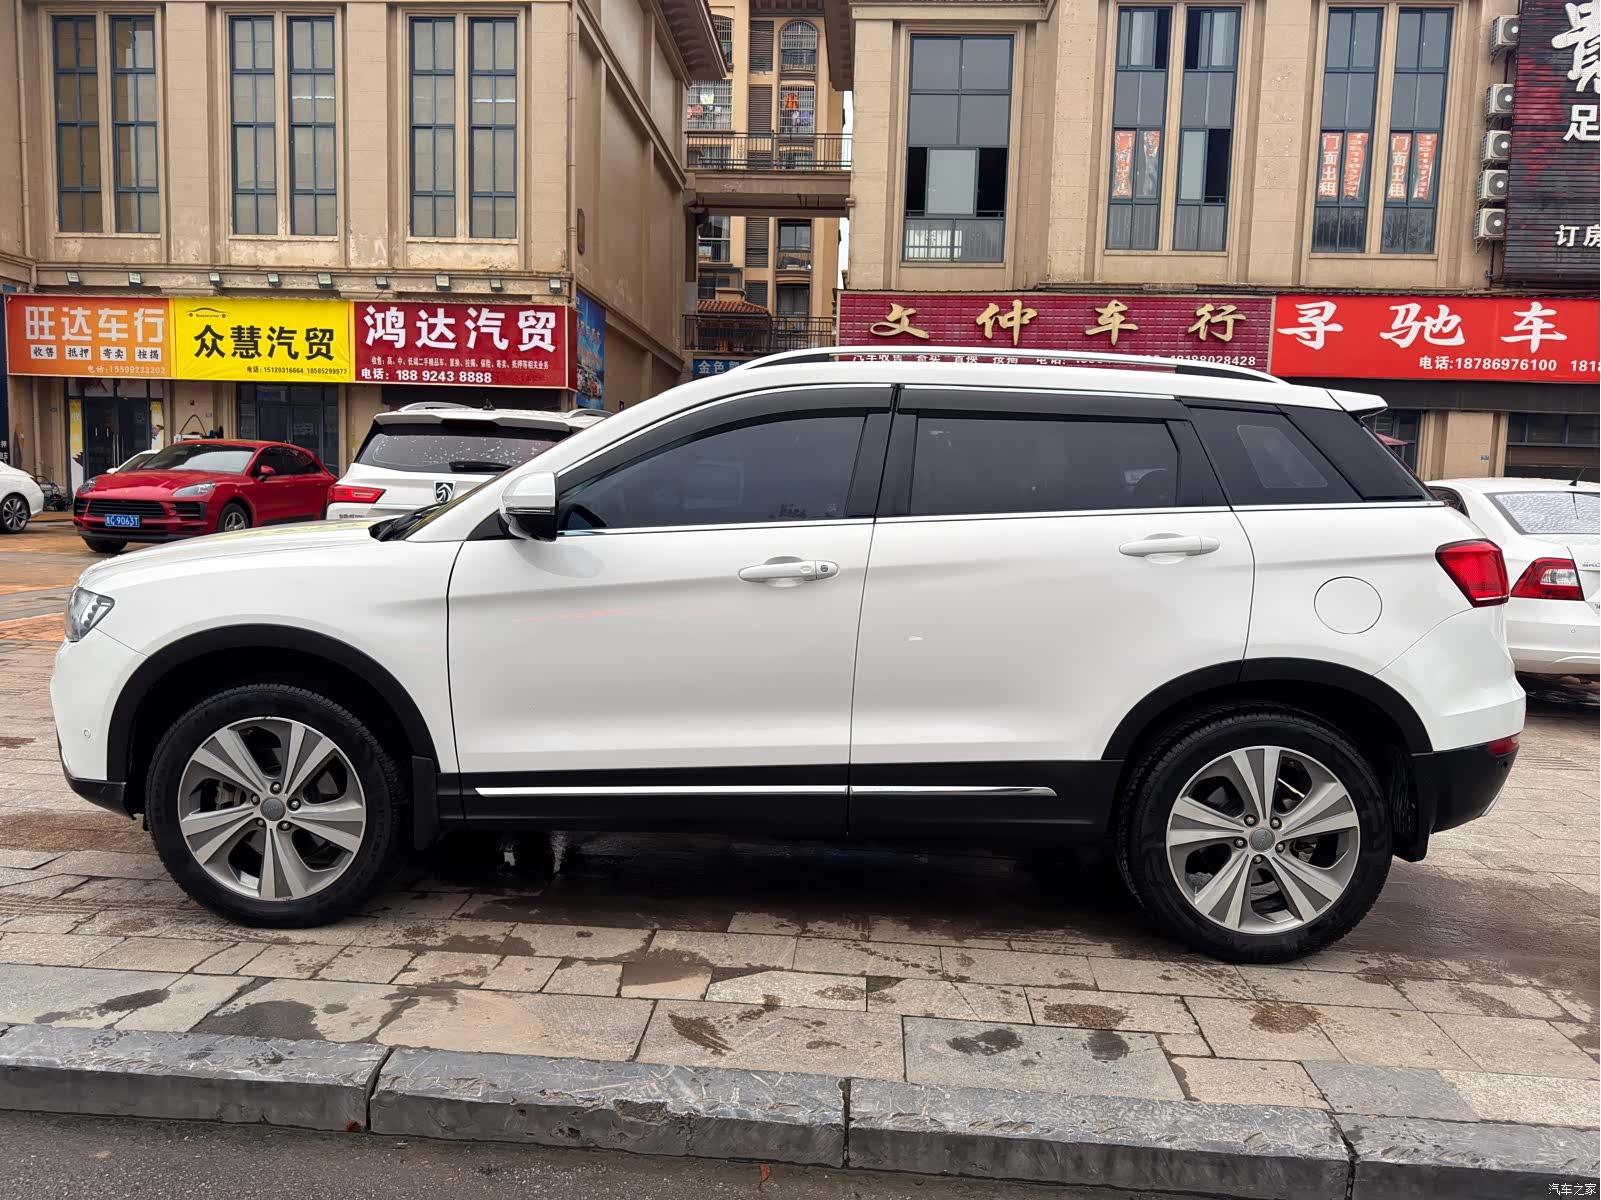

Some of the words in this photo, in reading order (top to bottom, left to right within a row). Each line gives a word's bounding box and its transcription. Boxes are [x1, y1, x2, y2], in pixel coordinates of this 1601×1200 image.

[1319, 135, 1340, 196] 门面出租
[25, 306, 165, 343] 旺达车行
[193, 324, 334, 361] 众慧汽贸
[363, 304, 557, 352] 鸿达汽贸
[869, 299, 1247, 346] 文仲车行
[1277, 300, 1568, 354] 寻驰车
[33, 346, 55, 358] 收售
[67, 347, 90, 358] 抵押
[102, 347, 125, 359] 寄卖
[137, 349, 160, 360] 按揭
[395, 370, 418, 381] 188
[422, 370, 455, 382] 9243
[459, 371, 492, 383] 8888
